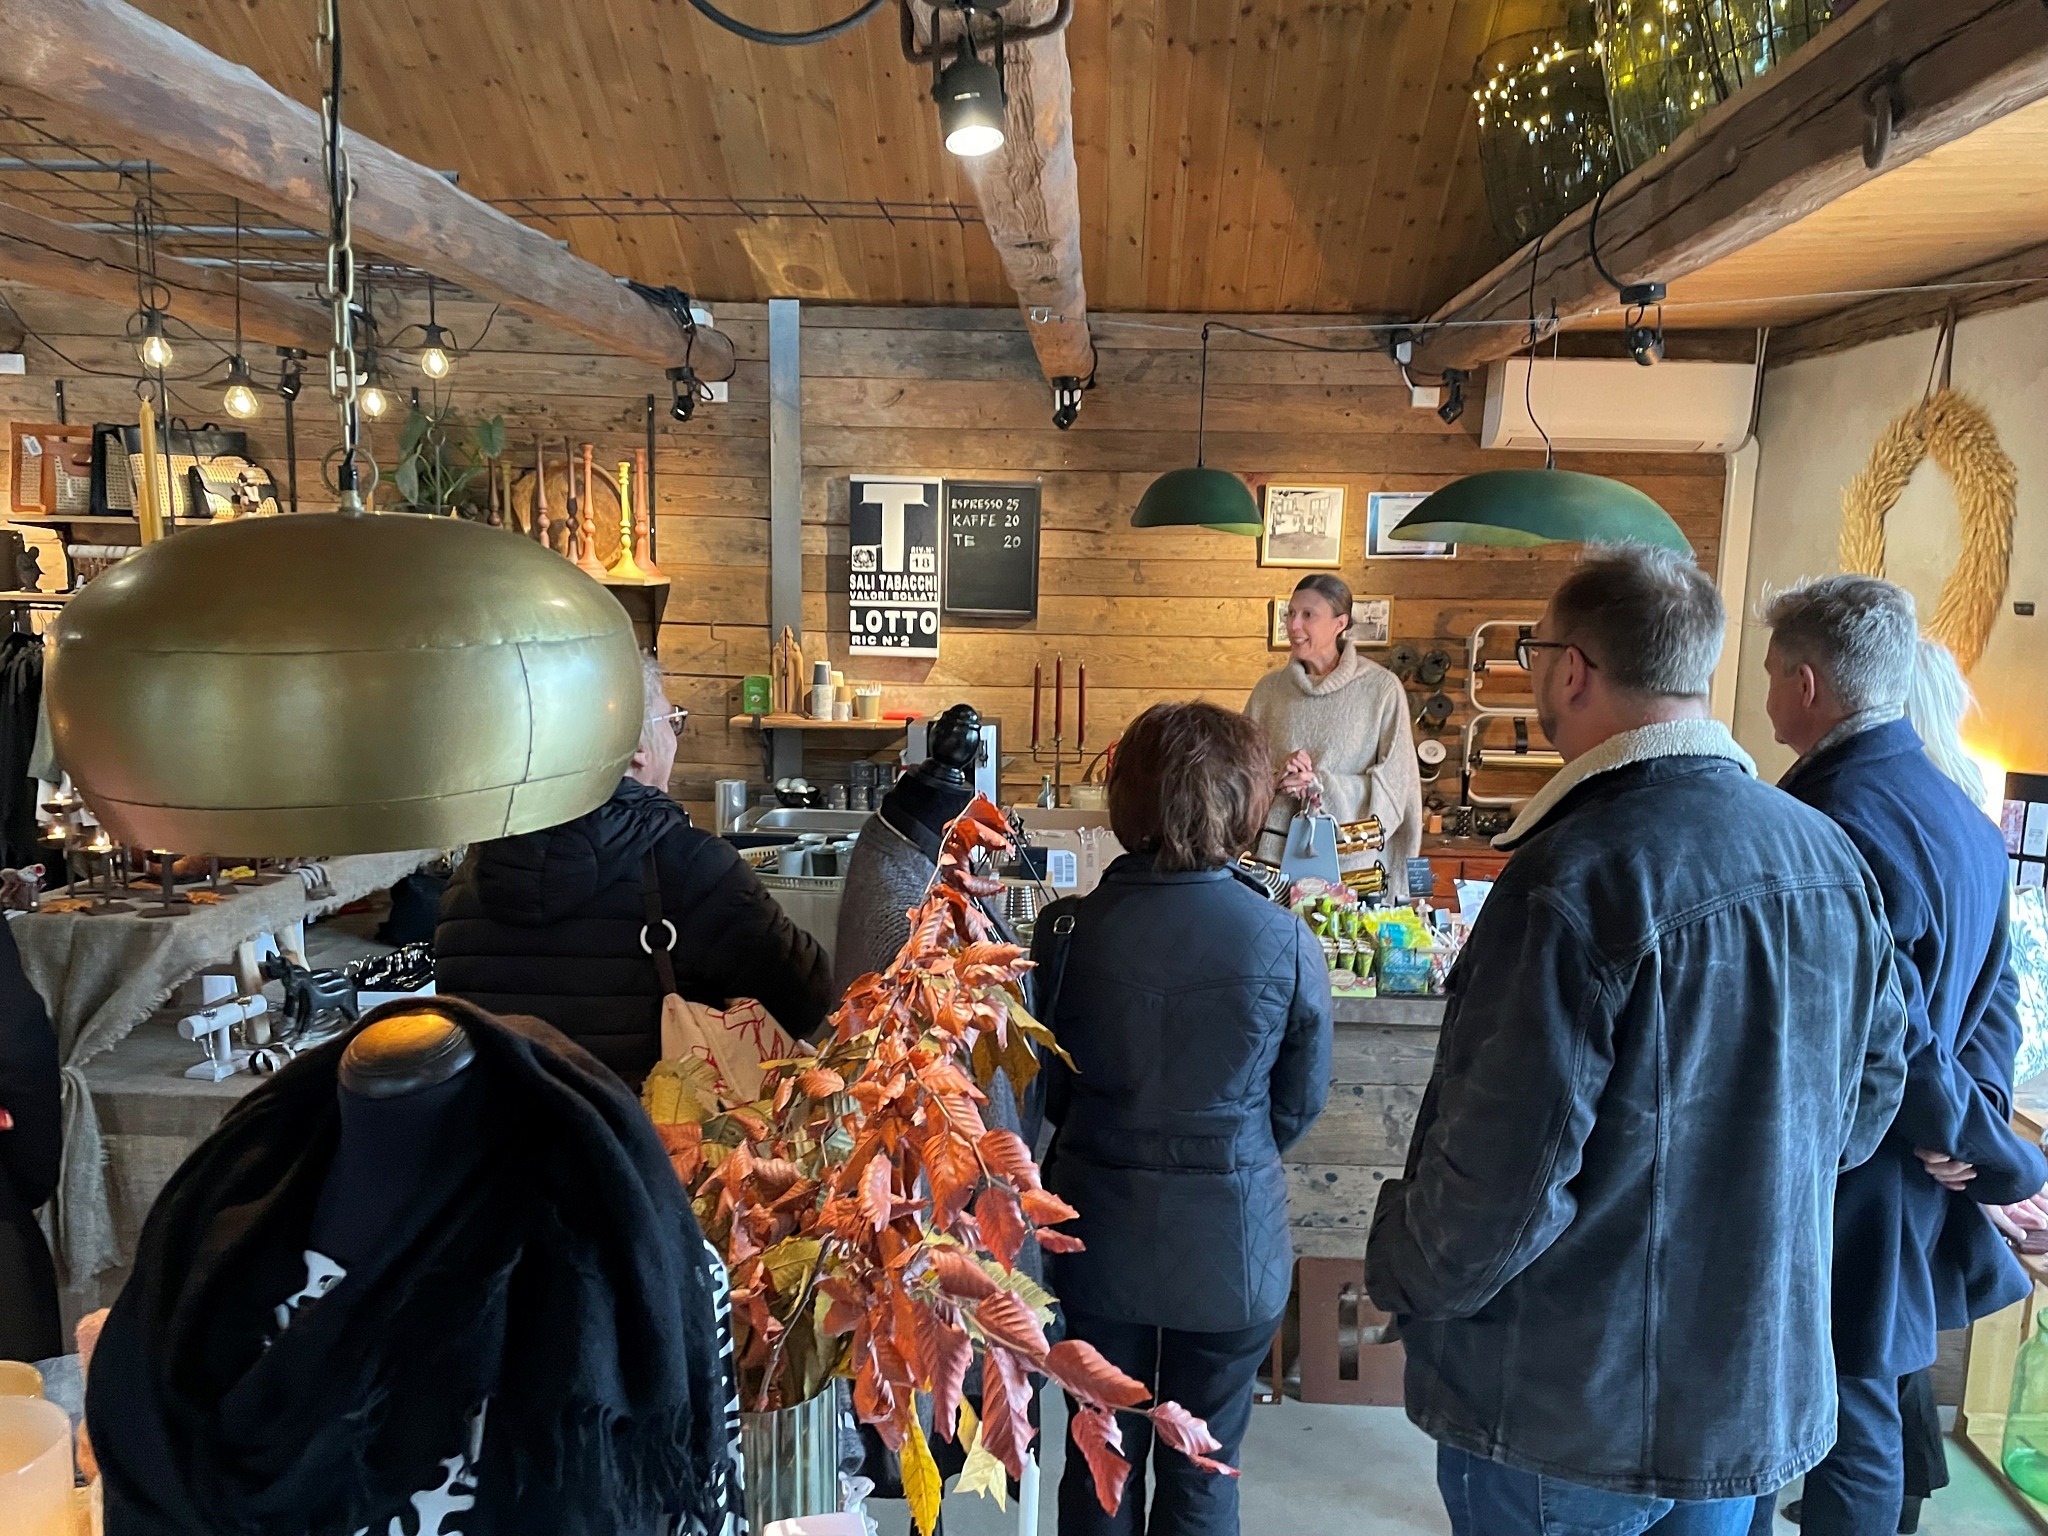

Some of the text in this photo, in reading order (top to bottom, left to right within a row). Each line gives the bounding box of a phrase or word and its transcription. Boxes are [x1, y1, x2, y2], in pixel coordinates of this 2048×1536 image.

[951, 498, 1020, 511] ESPRESSO 25
[860, 483, 928, 573] T
[952, 513, 1020, 528] KAFFE 20
[952, 533, 1021, 549] TE 20
[912, 557, 930, 568] 18
[849, 573, 938, 592] SALI TABACCHI
[849, 590, 938, 602] VALORI BOLLATI
[849, 609, 937, 635] LOTTO
[851, 635, 877, 646] RIC
